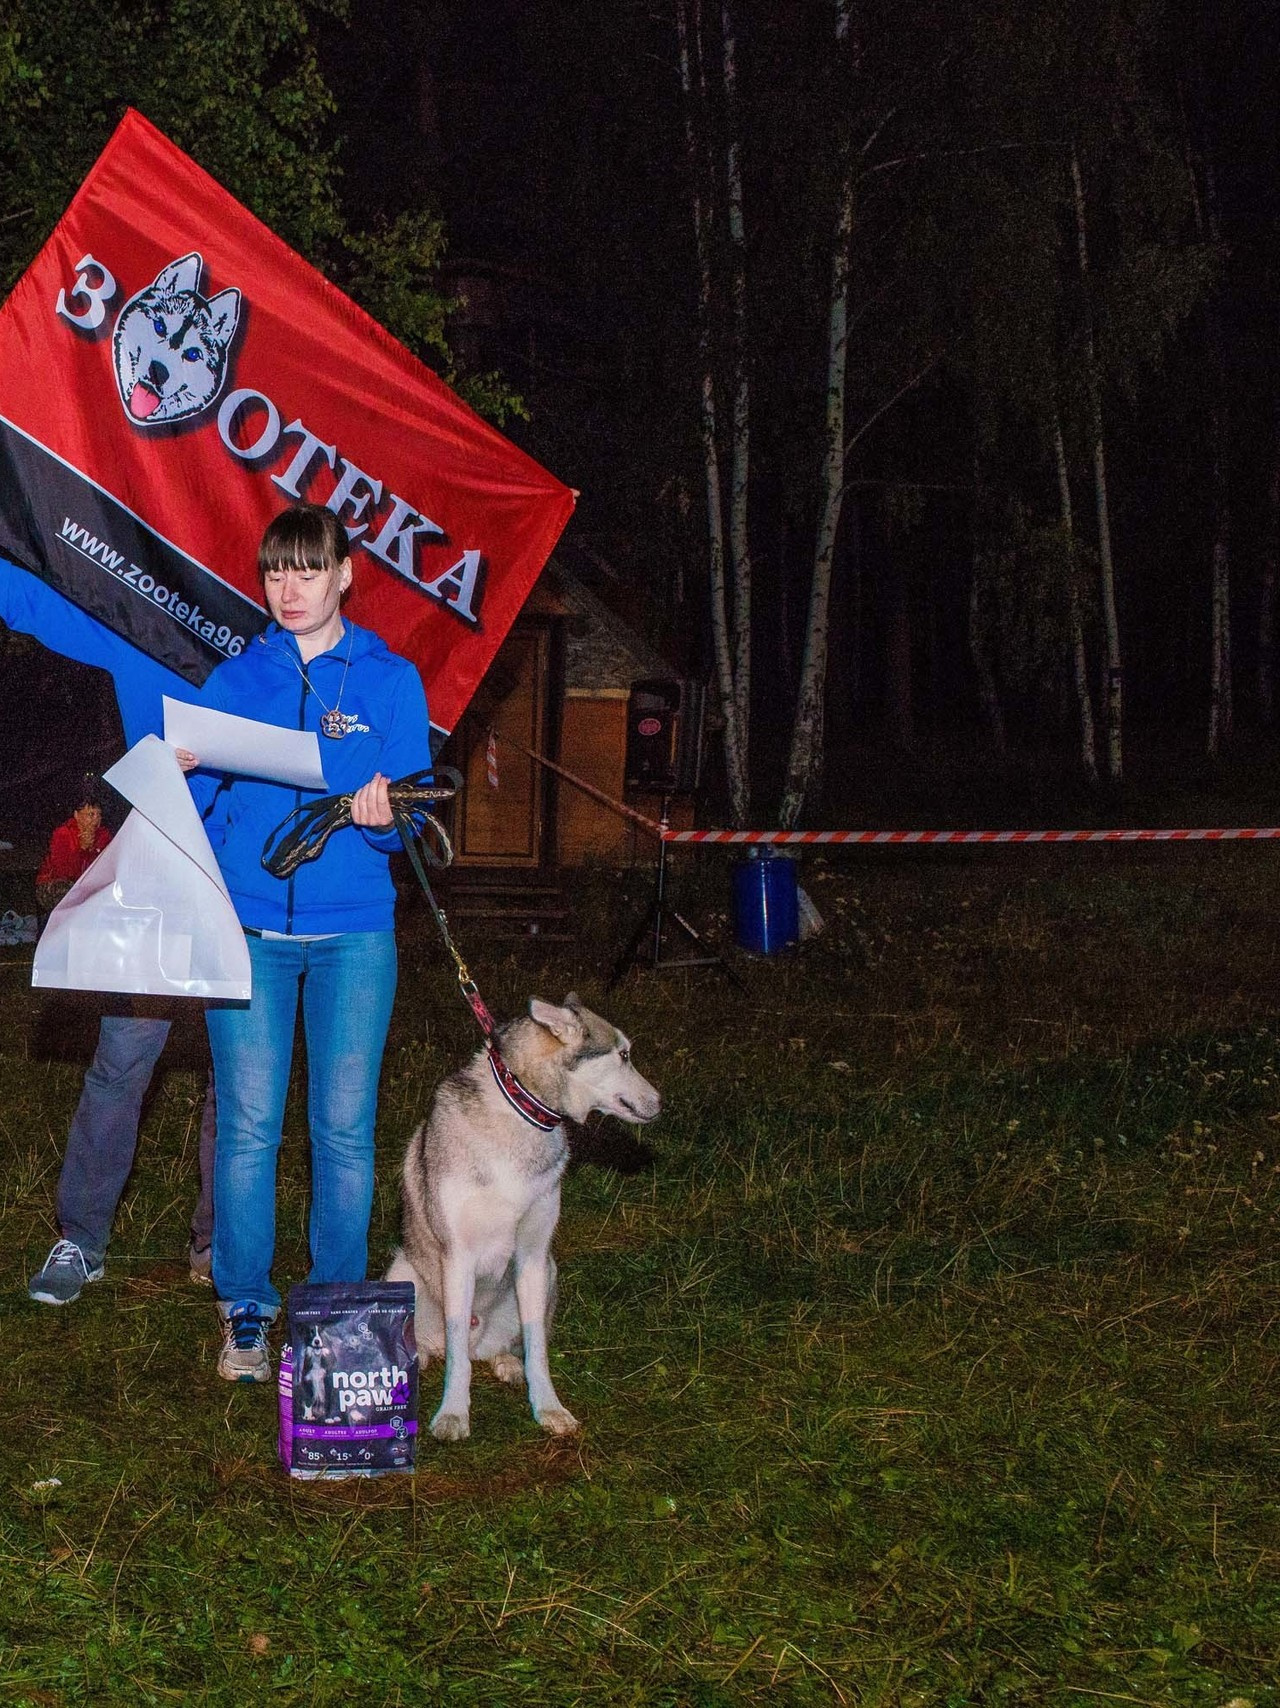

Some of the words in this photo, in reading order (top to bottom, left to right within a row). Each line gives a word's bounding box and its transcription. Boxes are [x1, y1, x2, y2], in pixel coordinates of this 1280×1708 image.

[217, 388, 483, 623] ОТЕКА
[60, 516, 247, 658] www.zooteka96
[332, 1365, 408, 1389] north
[339, 1389, 393, 1412] paw
